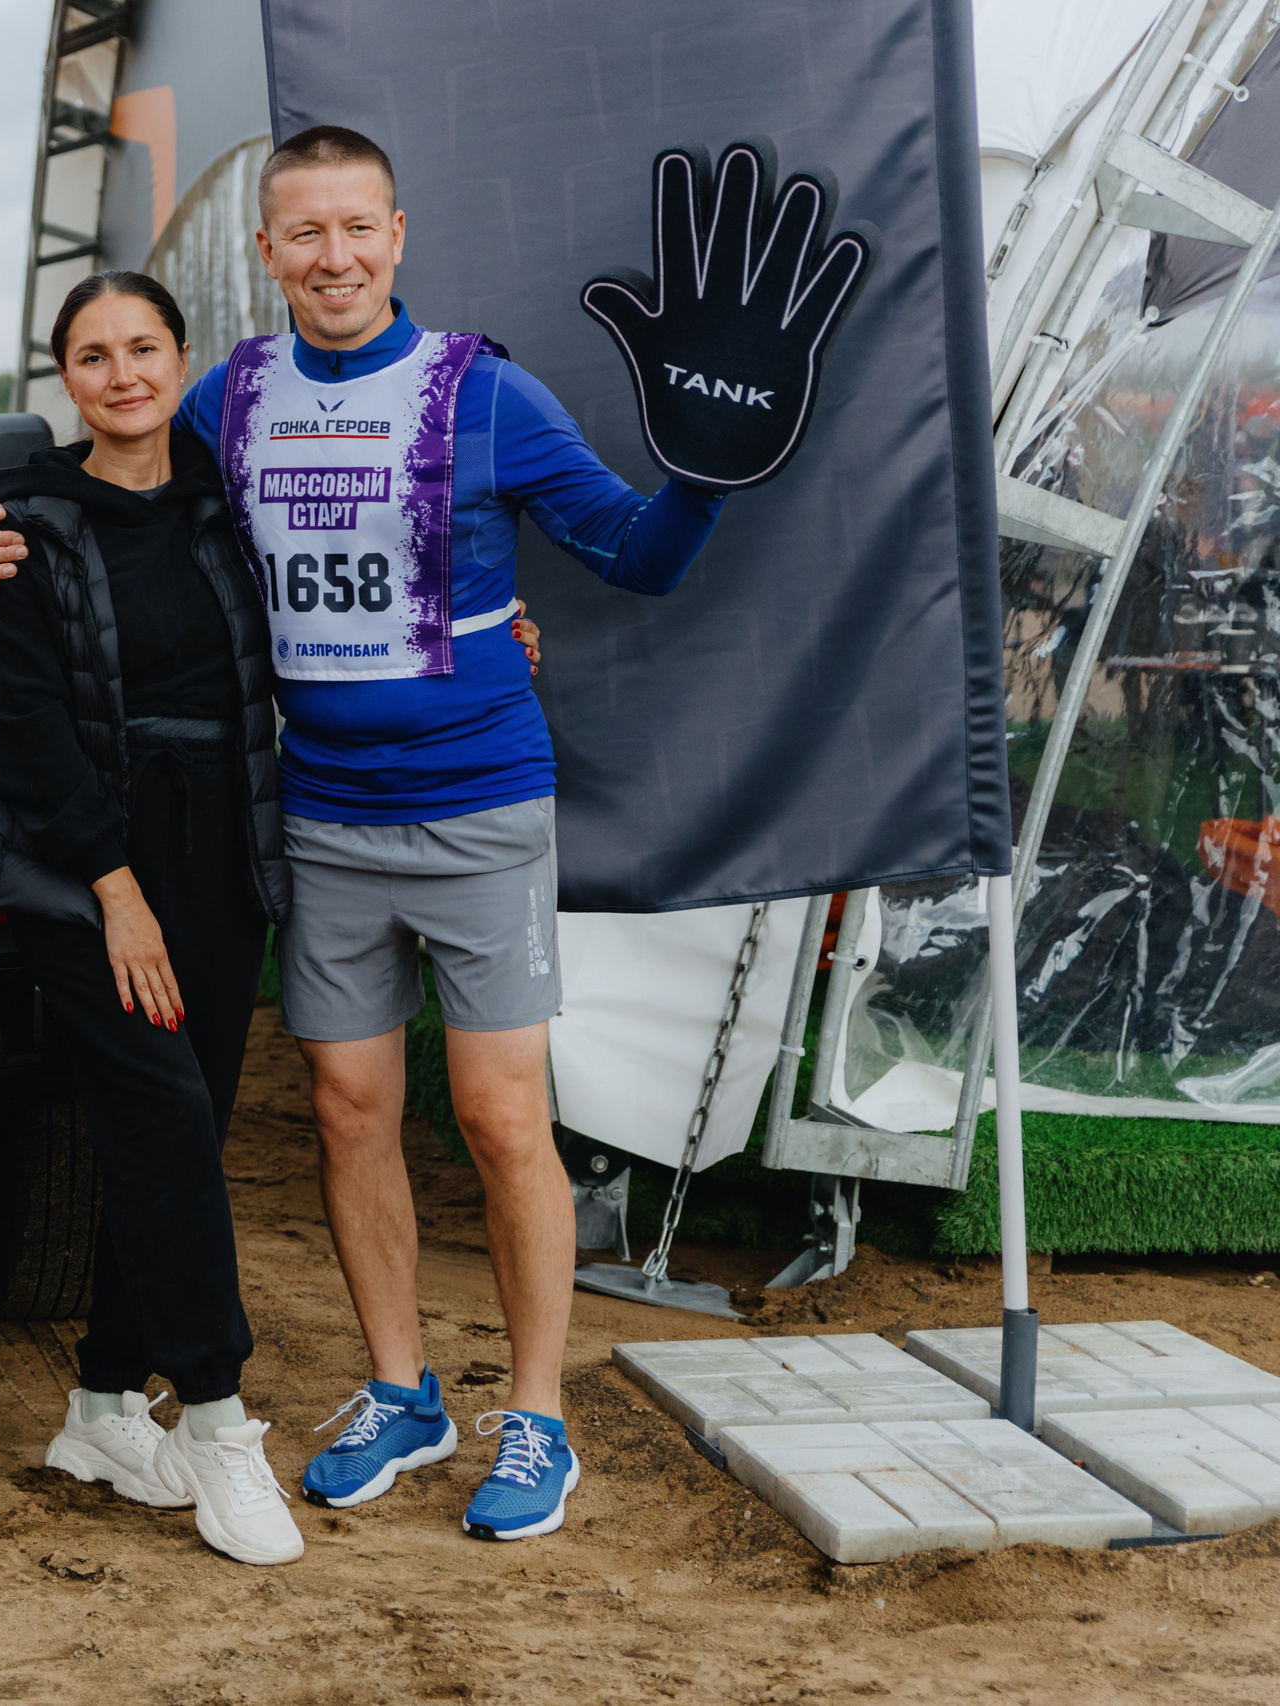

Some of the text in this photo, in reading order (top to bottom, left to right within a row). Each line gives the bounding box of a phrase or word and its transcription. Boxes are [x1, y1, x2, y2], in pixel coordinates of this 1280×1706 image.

[664, 363, 775, 409] TANK
[270, 419, 391, 435] ГОНКА ГЕРОЕВ
[264, 466, 386, 498] МАССОВЫЙ
[292, 501, 354, 528] СТАРТ
[265, 553, 393, 613] 1658
[296, 643, 390, 657] ГАЗПРОМБАНК
